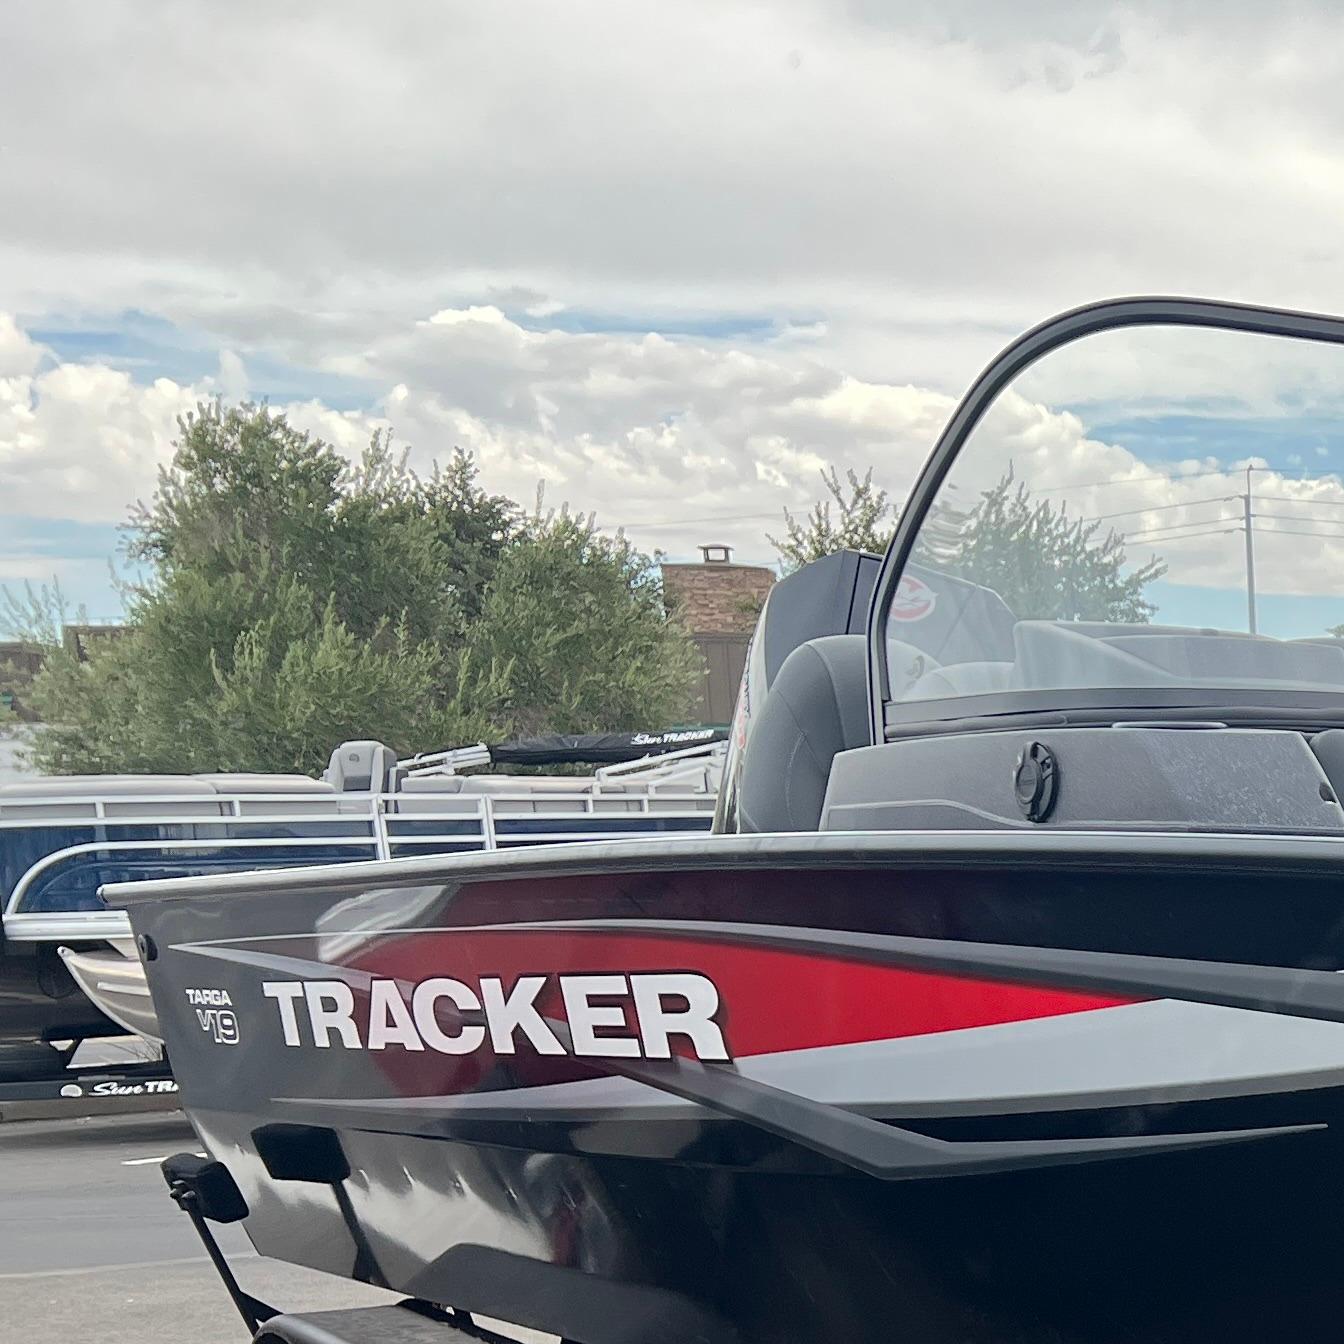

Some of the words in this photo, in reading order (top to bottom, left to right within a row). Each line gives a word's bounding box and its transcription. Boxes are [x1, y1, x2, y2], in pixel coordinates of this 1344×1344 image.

[185, 988, 232, 1006] TARGA
[195, 1009, 240, 1045] V19
[263, 973, 731, 1062] TRACKER
[88, 1081, 143, 1096] Sun
